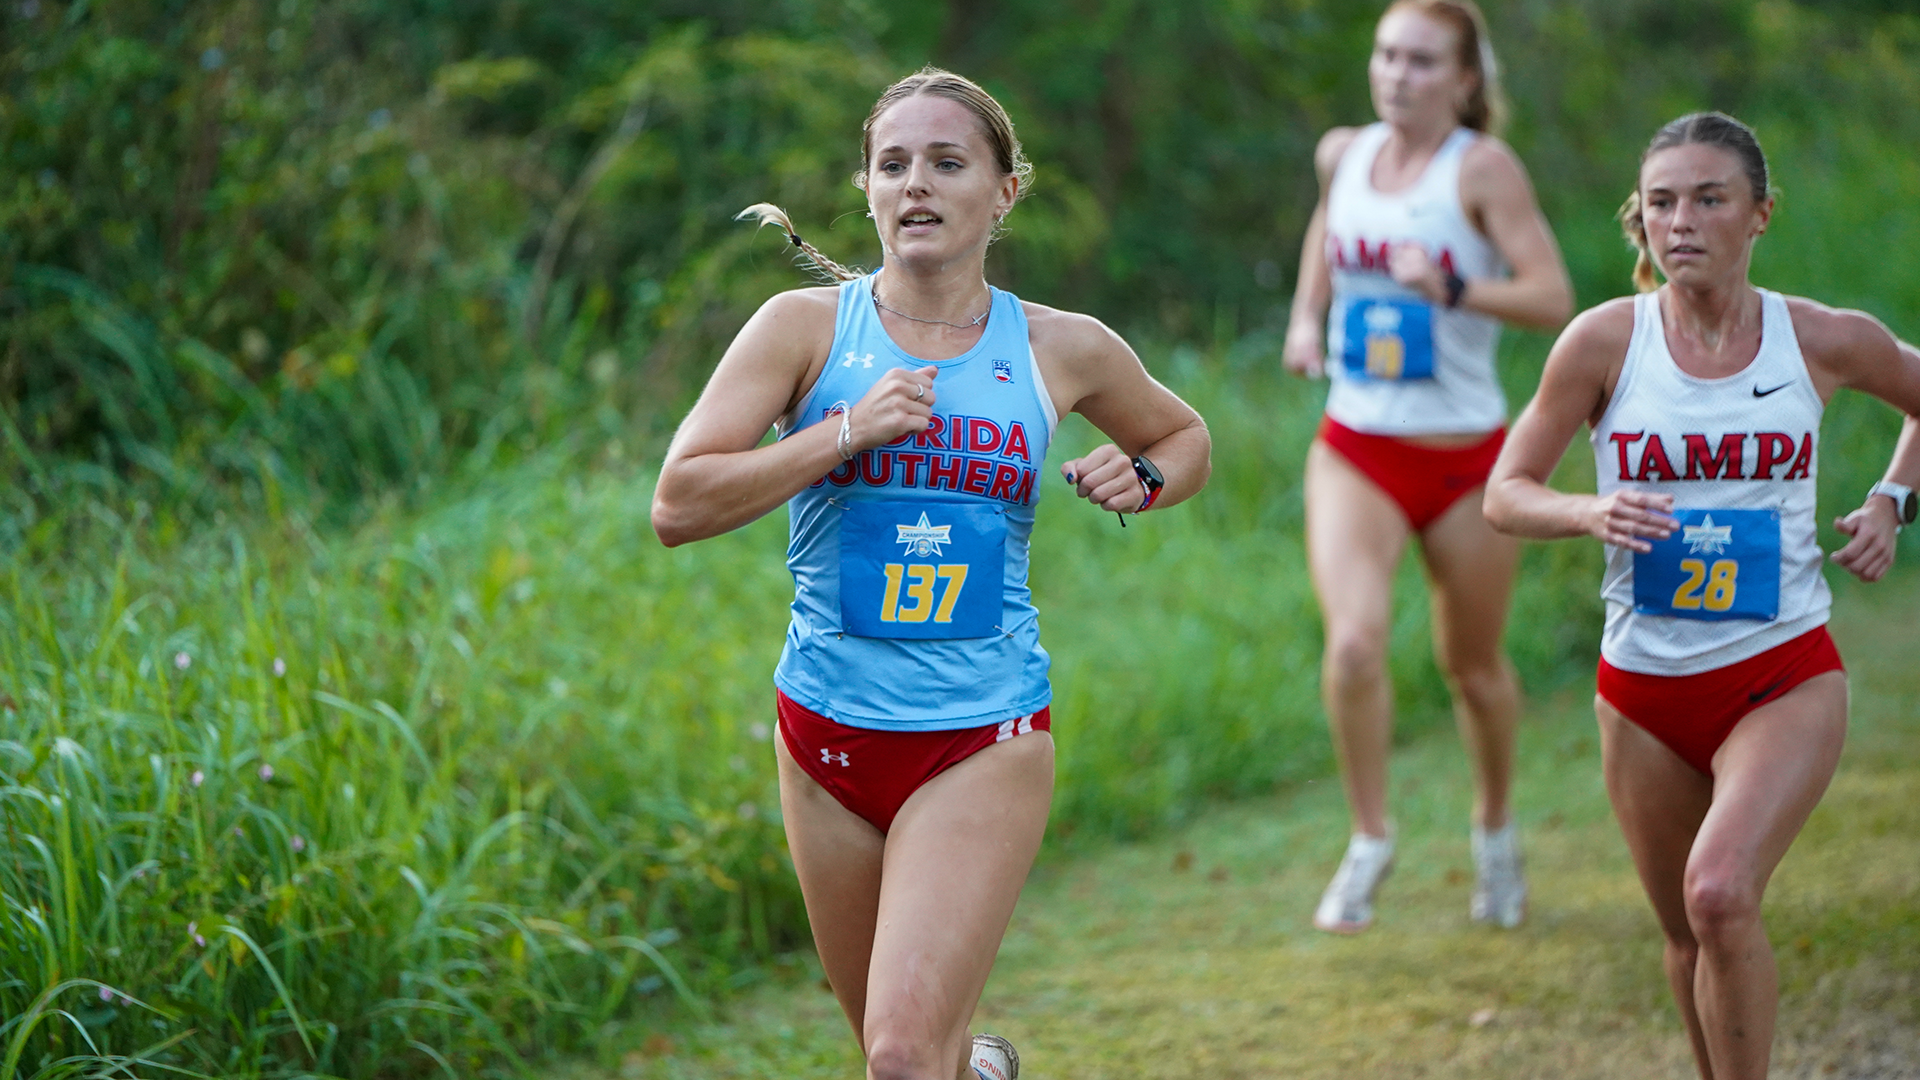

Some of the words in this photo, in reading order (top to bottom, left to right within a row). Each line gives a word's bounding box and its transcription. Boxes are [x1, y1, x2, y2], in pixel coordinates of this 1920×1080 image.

[822, 408, 1031, 464] RIDA
[1609, 430, 1812, 480] TAMPA
[808, 450, 1038, 506] OUTHERN
[880, 563, 969, 622] 137
[1671, 559, 1738, 611] 28
